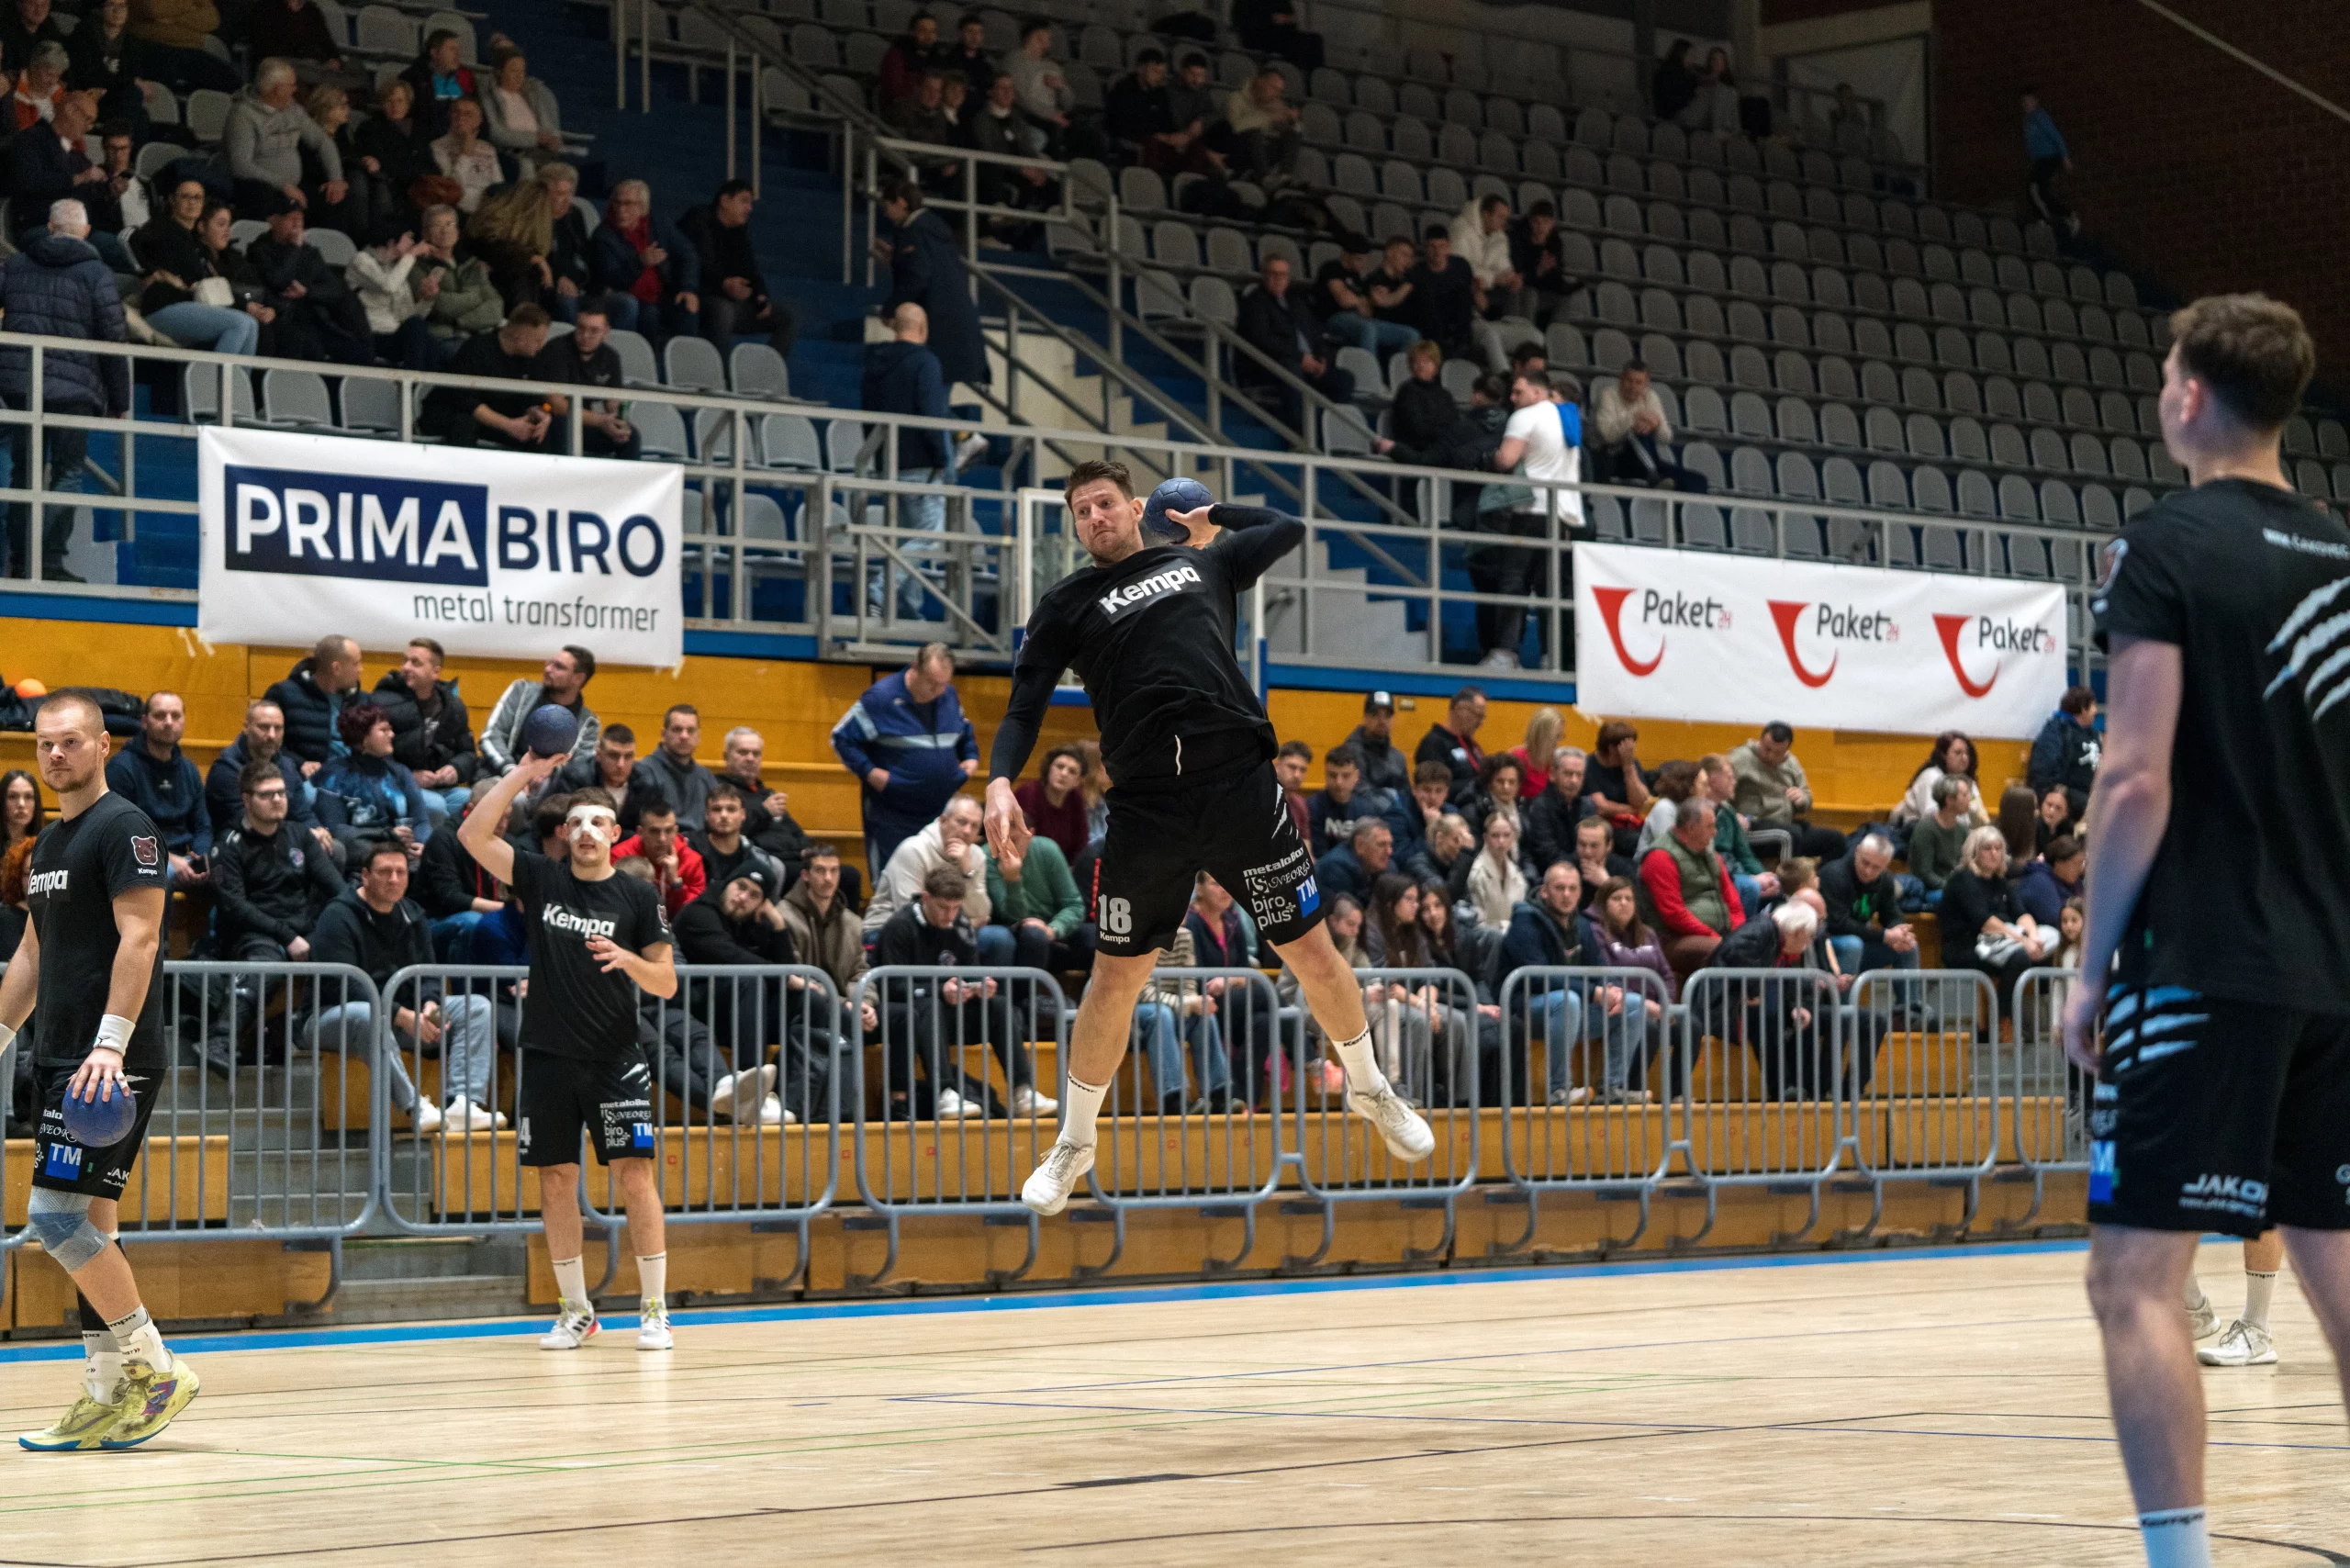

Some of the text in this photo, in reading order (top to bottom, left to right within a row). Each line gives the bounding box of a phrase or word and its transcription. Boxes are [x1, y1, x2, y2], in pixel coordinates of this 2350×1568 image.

[235, 483, 666, 577] PRIMA BIRO
[1100, 565, 1202, 615] Kempa
[414, 591, 660, 633] metal transformer
[1295, 875, 1318, 902] TM
[1098, 893, 1133, 935] 18
[1251, 895, 1286, 913] biro
[542, 902, 616, 939] Kempa
[1100, 931, 1131, 945] Kempa
[604, 1124, 624, 1137] biro
[632, 1122, 654, 1137] TM
[50, 1142, 83, 1166] TM
[107, 1167, 130, 1182] JAK
